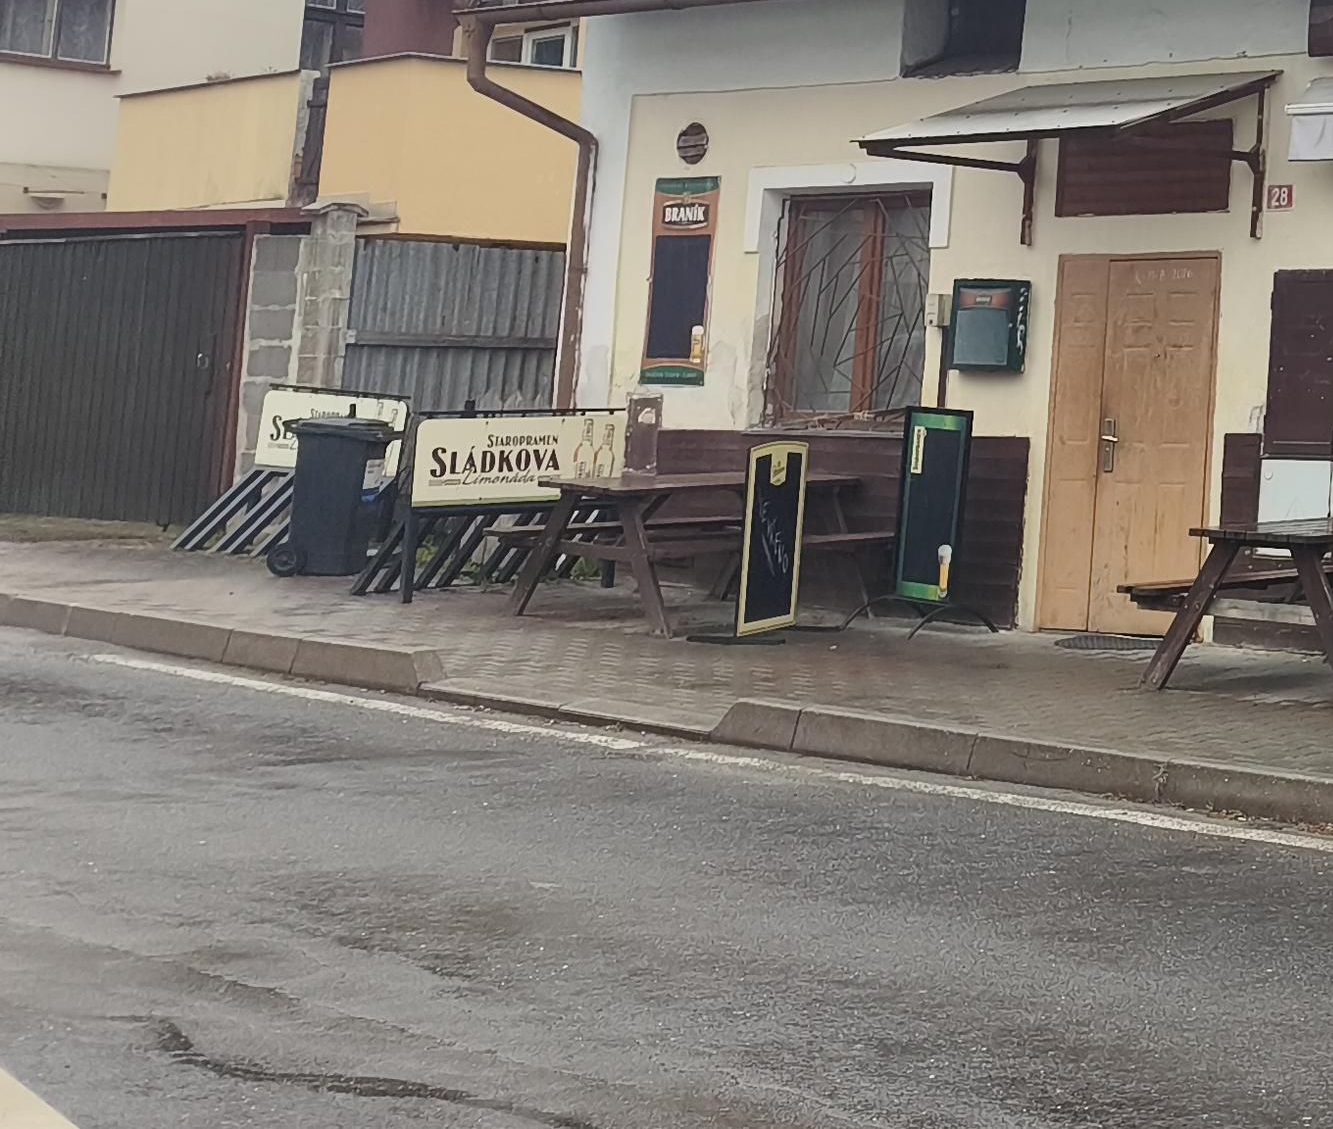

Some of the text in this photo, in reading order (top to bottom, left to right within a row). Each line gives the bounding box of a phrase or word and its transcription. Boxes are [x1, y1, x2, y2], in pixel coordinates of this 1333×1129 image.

[1271, 187, 1288, 206] 28
[664, 203, 705, 223] BRANÍK
[487, 434, 559, 448] STAROPRAMEN
[430, 446, 560, 478] SLÁDKOVA
[462, 471, 536, 485] Limonáda
